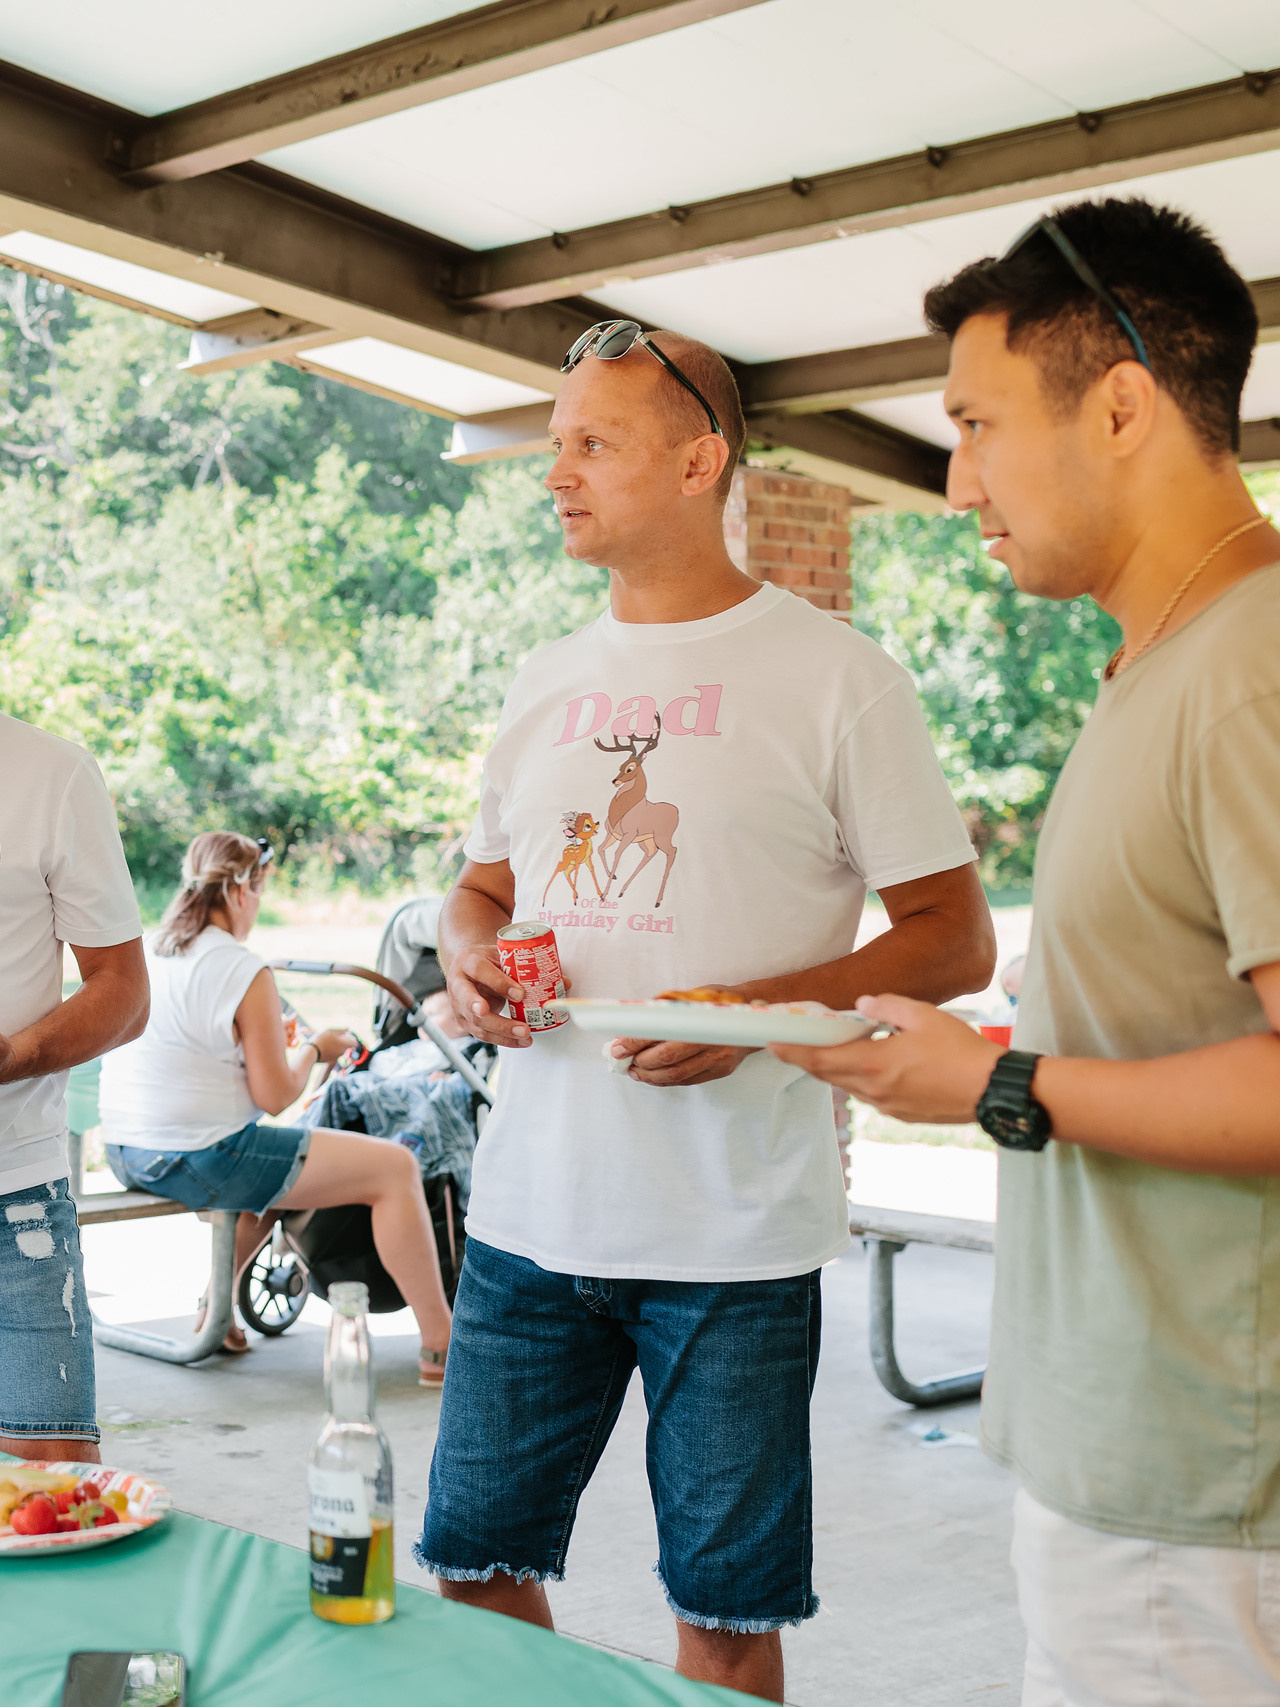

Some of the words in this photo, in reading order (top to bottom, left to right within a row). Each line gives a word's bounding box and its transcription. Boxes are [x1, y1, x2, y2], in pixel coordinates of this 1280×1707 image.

[553, 684, 723, 746] Dad
[580, 898, 597, 909] Of
[598, 899, 619, 910] the
[627, 914, 675, 934] Girl
